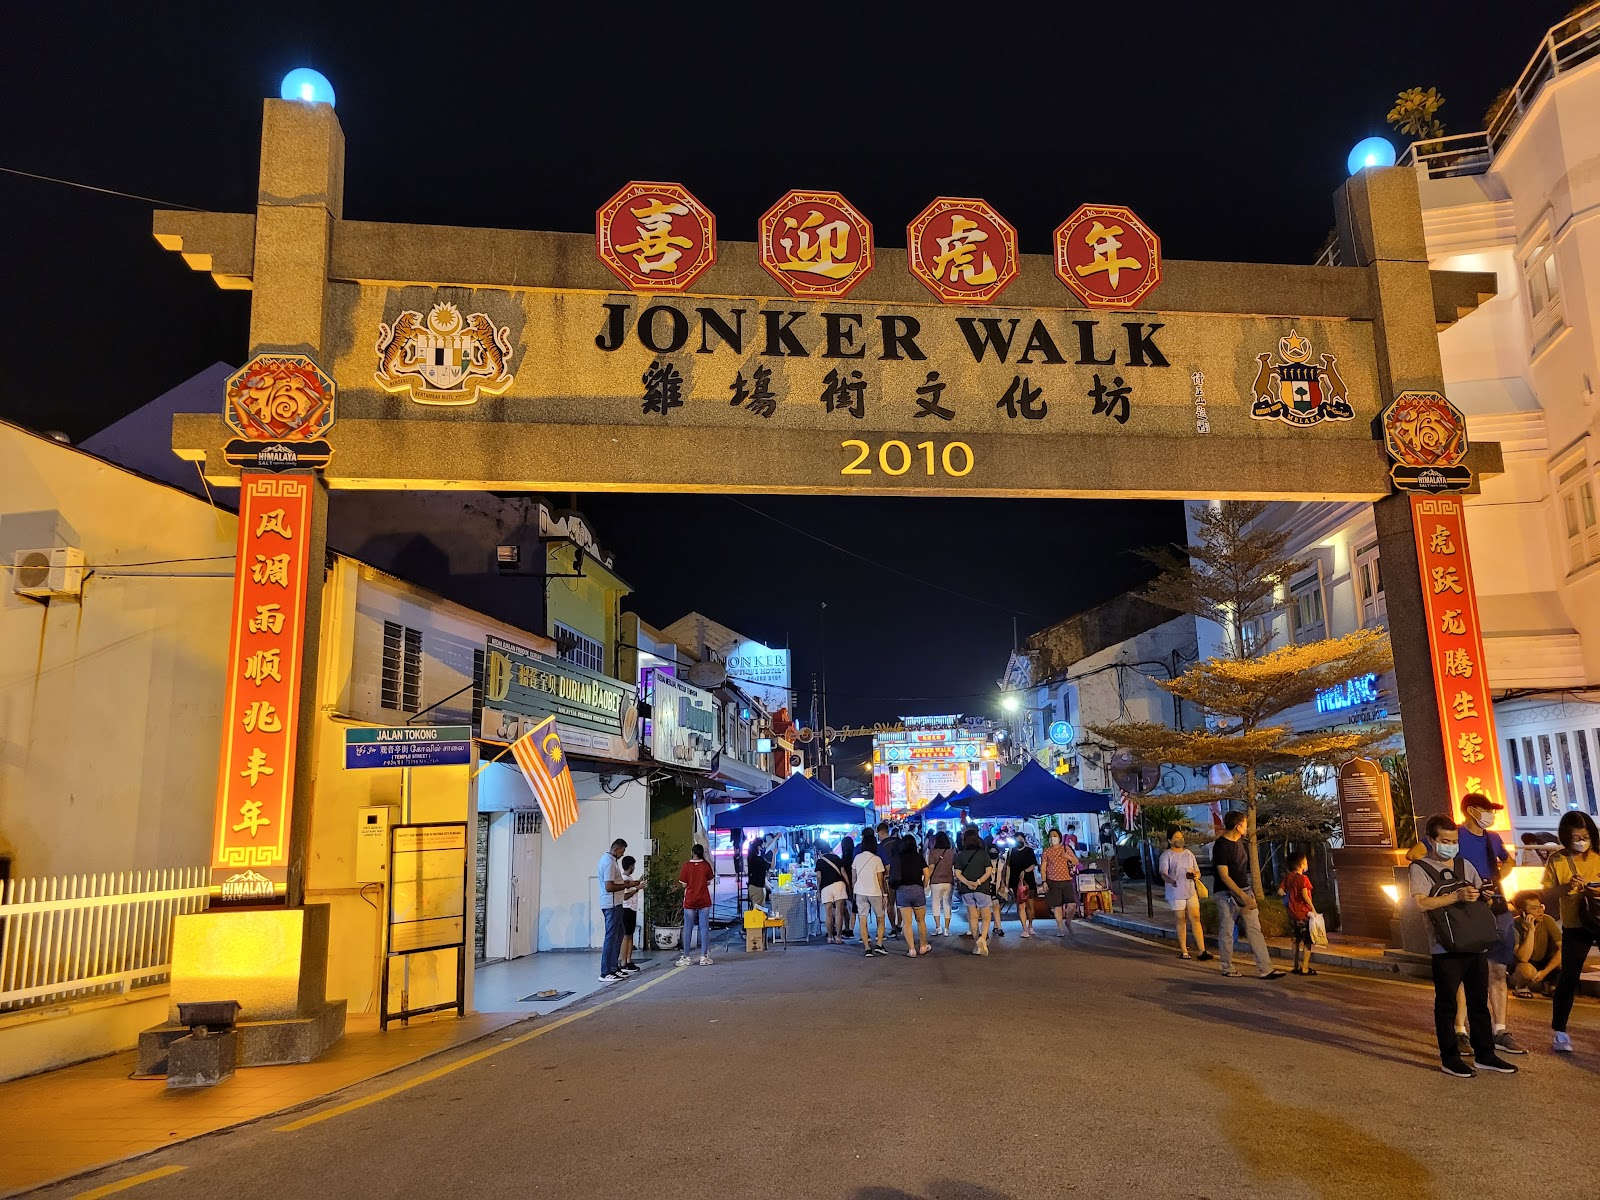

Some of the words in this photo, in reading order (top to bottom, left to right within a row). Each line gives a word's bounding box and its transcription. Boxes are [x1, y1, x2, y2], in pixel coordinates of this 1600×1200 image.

[615, 198, 1143, 291] 喜迎虎年
[595, 302, 927, 361] JONKER
[956, 317, 1172, 367] WALK
[1287, 413, 1321, 424] MELAKA
[258, 452, 297, 461] HIMALAYA
[840, 439, 975, 477] 2010
[1418, 476, 1447, 484] HIMALAYA
[728, 655, 786, 668] ONKER
[231, 507, 294, 838] 风调雨顺兆丰年
[560, 676, 592, 705] DURIAN
[592, 680, 620, 713] BAOBEI
[376, 730, 403, 741] JALAN
[404, 729, 438, 740] TOKONG
[222, 881, 274, 895] HIMALAYA
